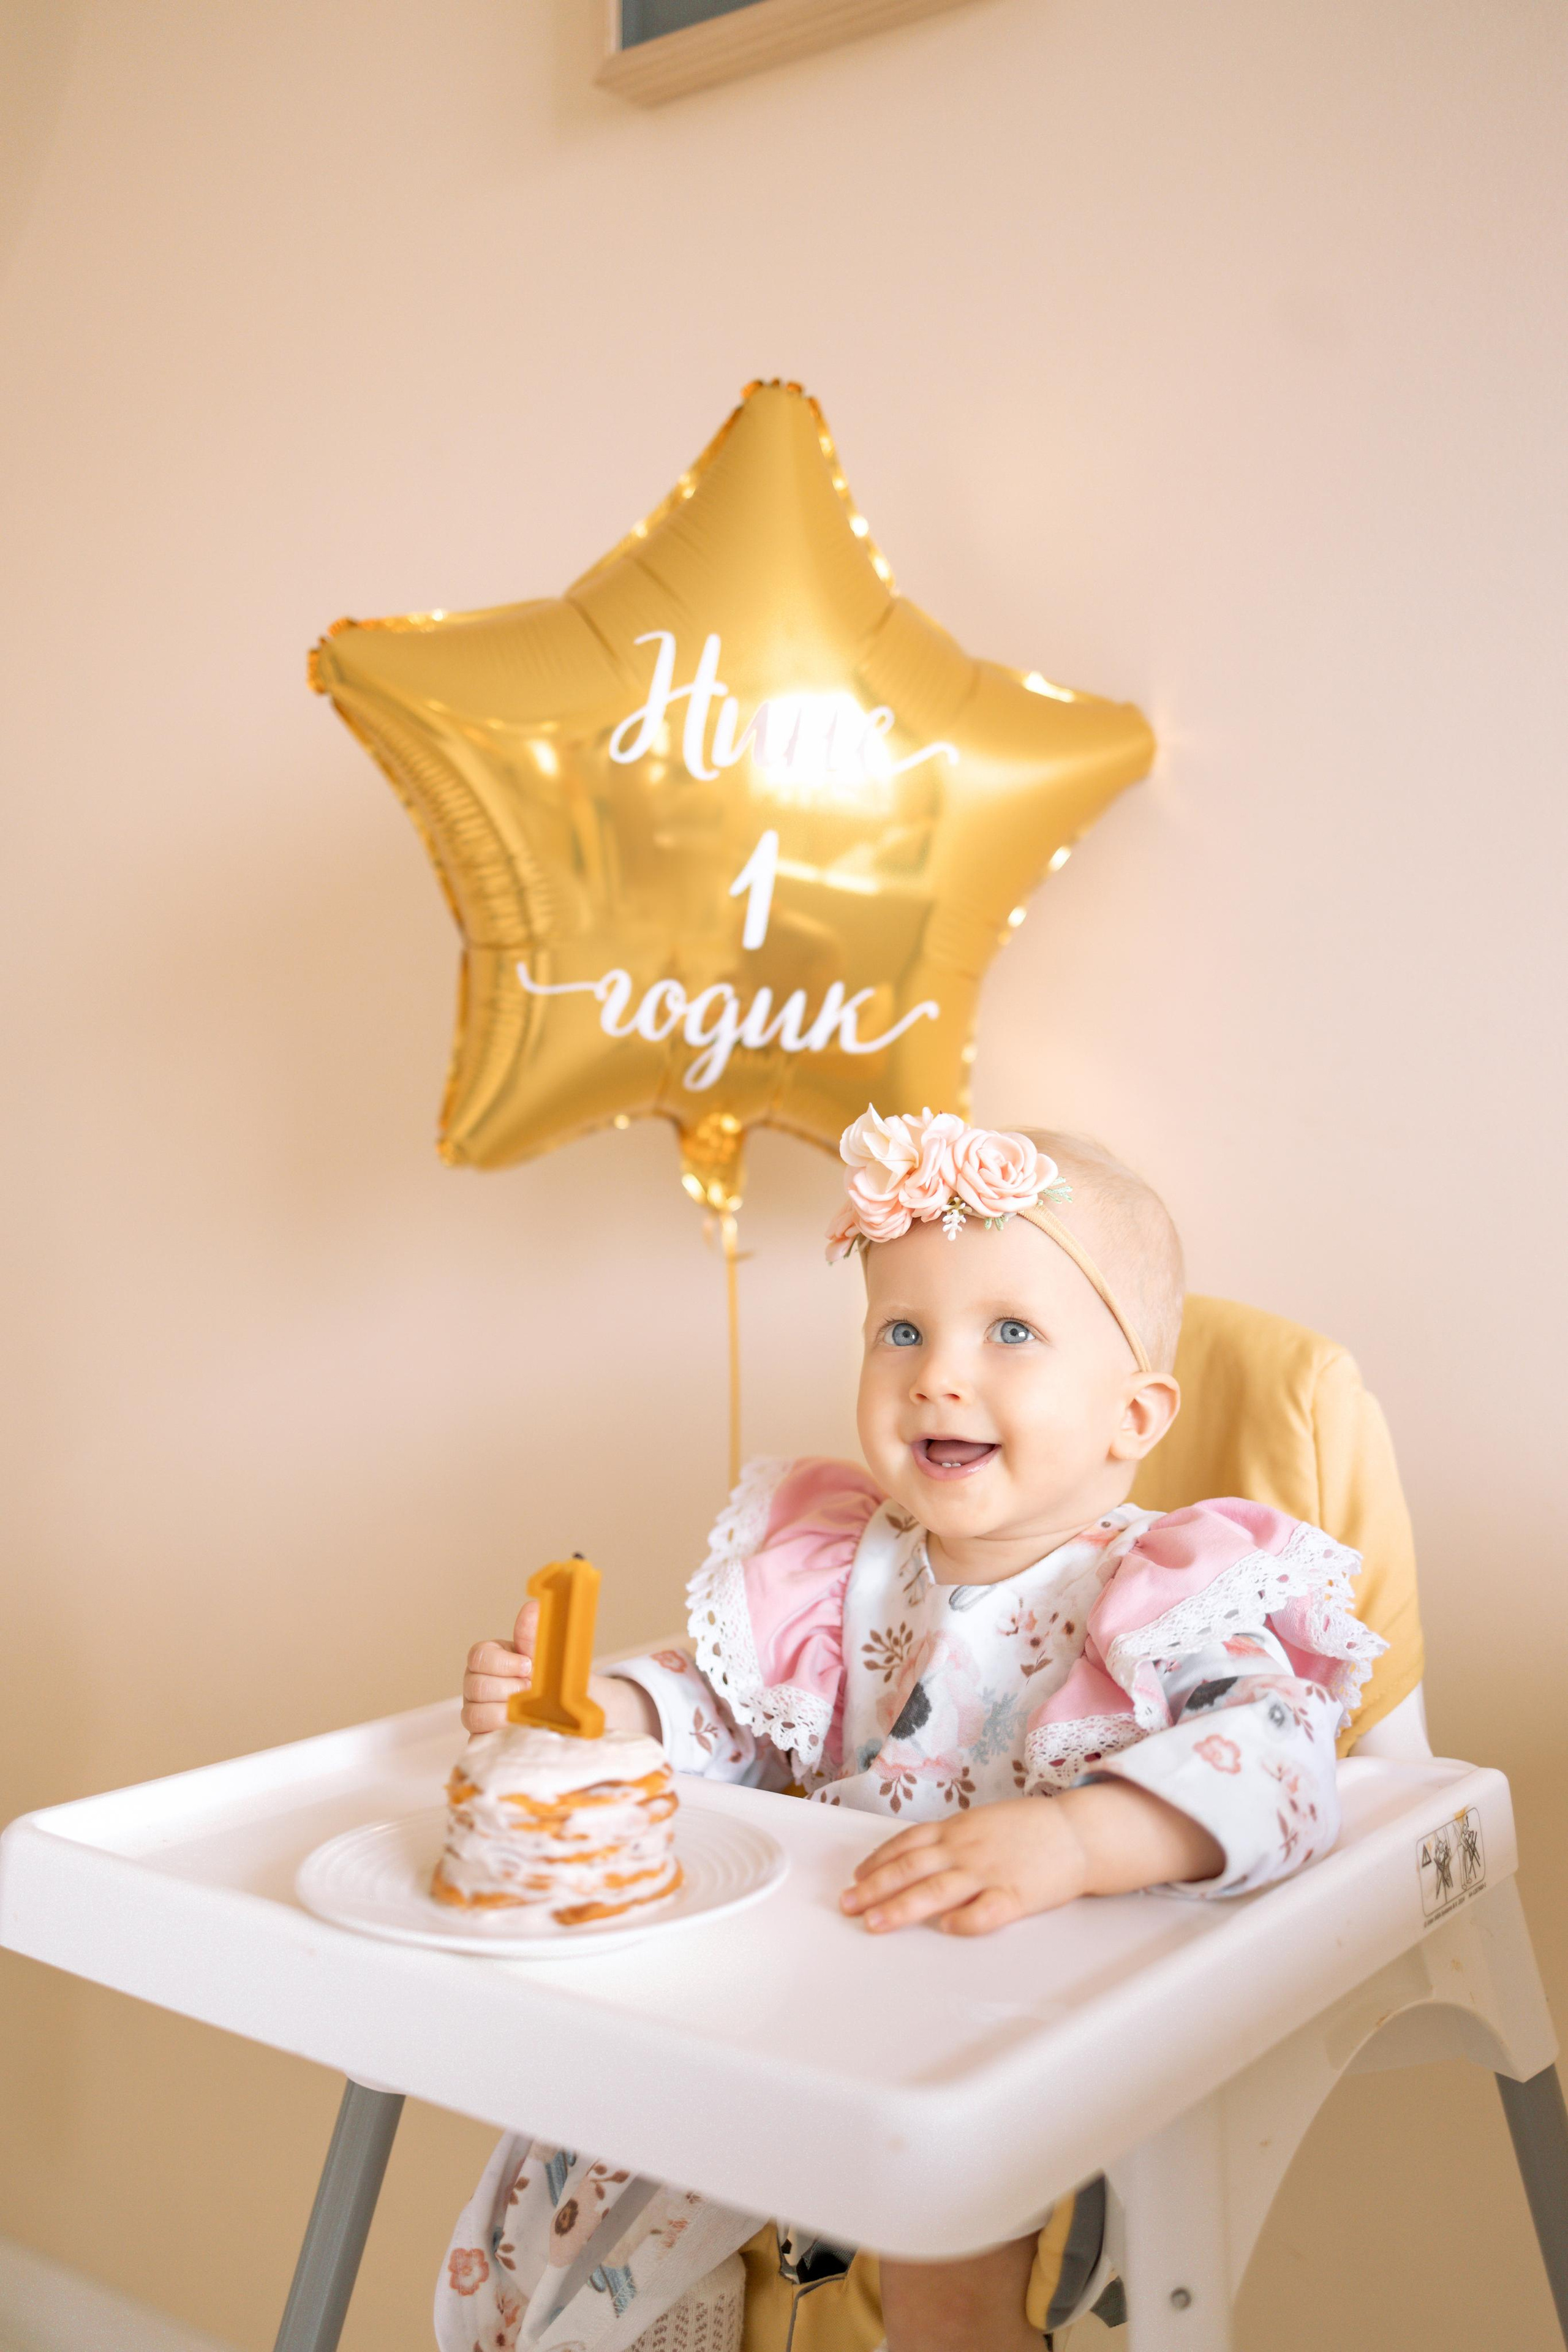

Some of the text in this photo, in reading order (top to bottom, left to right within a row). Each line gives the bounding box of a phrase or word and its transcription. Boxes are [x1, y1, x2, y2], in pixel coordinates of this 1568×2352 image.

[729, 829, 778, 950] 1
[516, 962, 940, 1091] годик
[506, 1560, 606, 1740] 1
